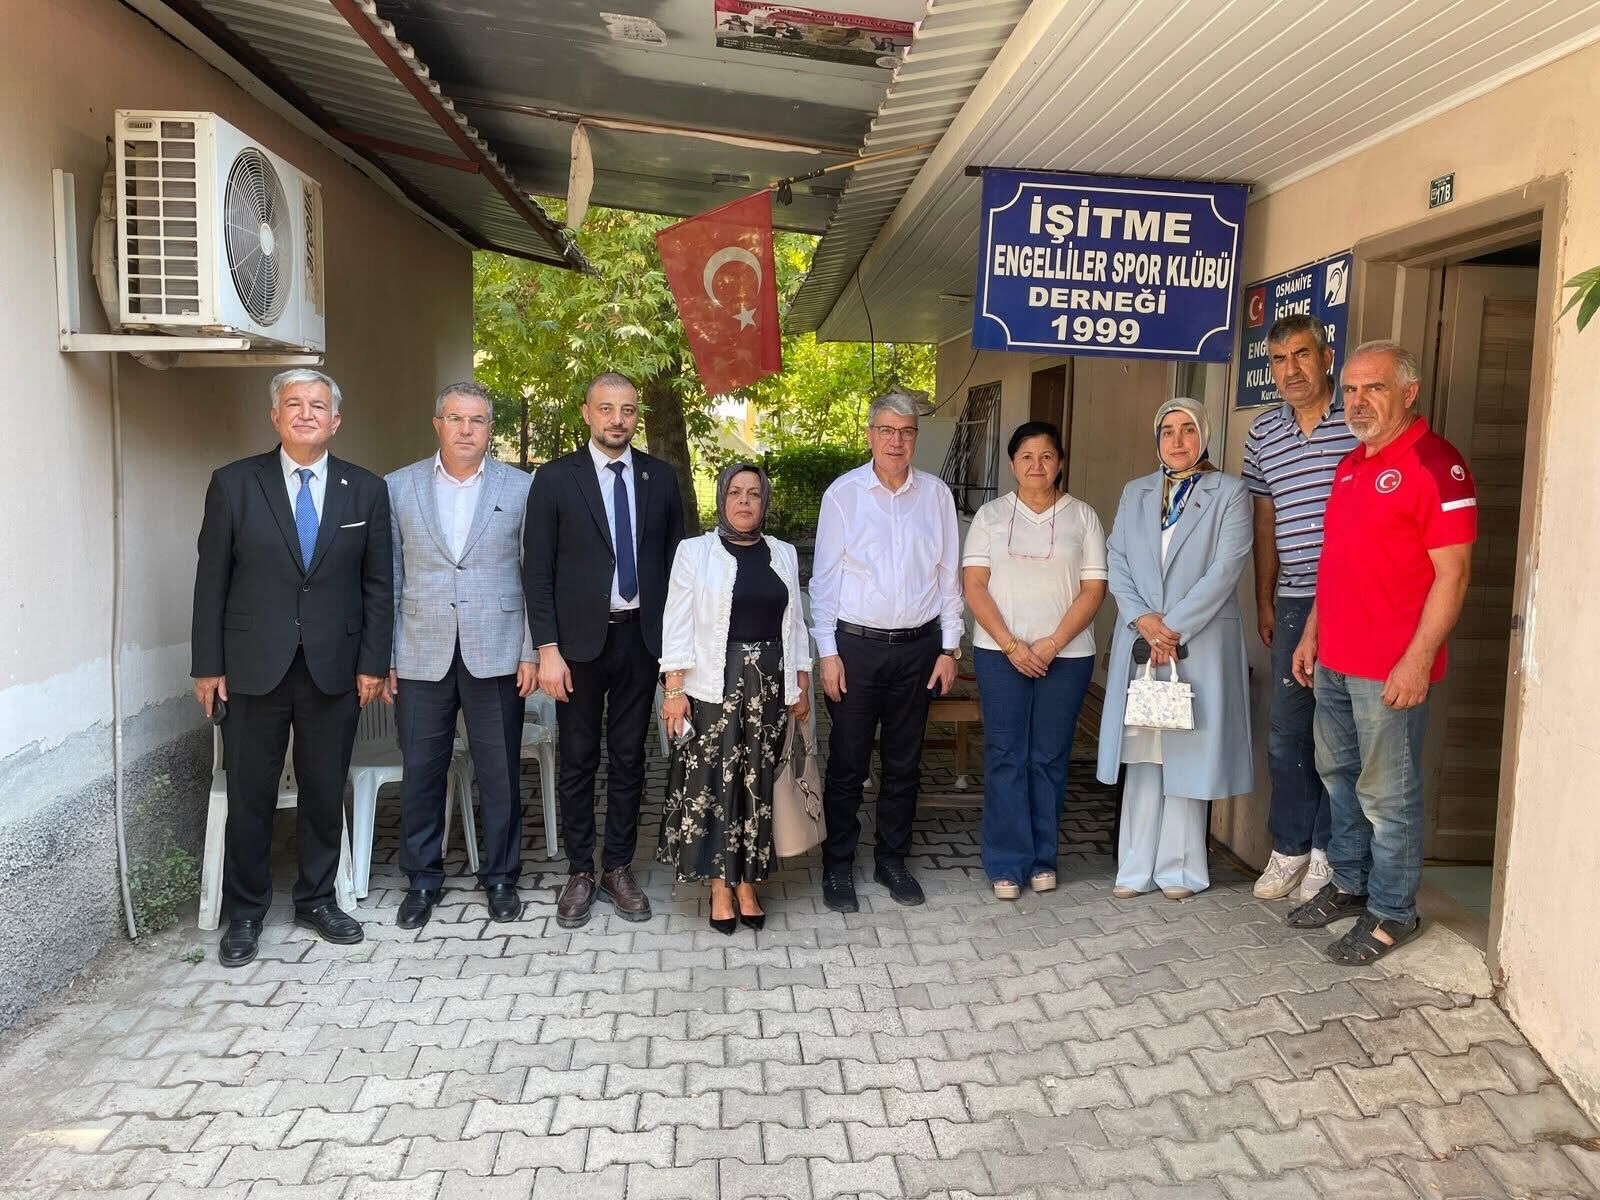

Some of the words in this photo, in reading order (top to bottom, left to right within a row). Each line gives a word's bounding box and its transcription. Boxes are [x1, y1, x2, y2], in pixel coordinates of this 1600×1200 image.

[1029, 195, 1192, 244] İŞİTME
[993, 241, 1108, 283] ENGELLİLER
[1112, 251, 1161, 286] SPOR
[1166, 250, 1231, 289] KLÜBÜ
[1028, 286, 1167, 315] DERNEĞİ
[1275, 273, 1312, 298] OSMANİYE
[1051, 314, 1141, 345] 1999
[1246, 363, 1276, 388] KULÜ
